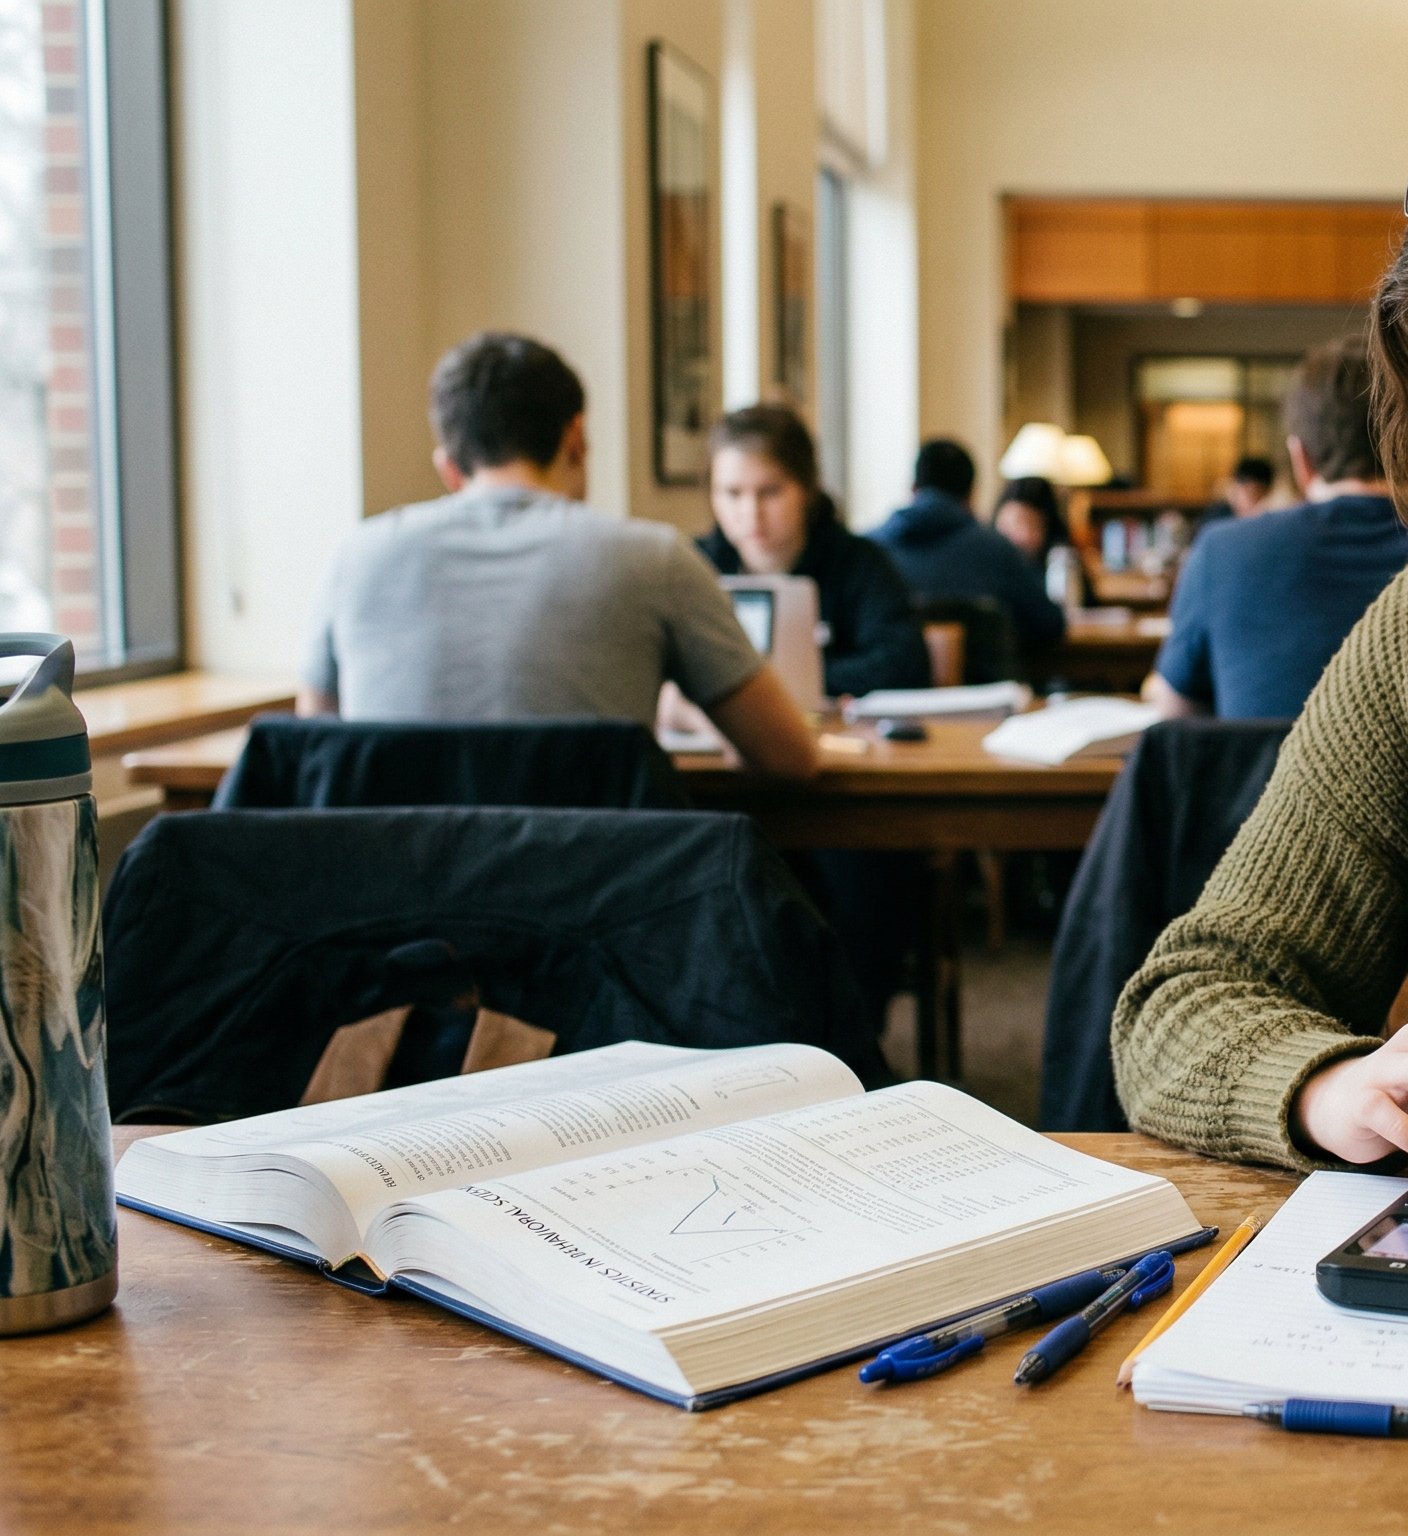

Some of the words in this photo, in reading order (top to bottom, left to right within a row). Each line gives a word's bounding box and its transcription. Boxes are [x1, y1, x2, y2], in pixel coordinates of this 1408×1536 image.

[503, 1204, 586, 1259] BEHAVIORAL
[579, 1257, 606, 1269] IN
[597, 1267, 676, 1303] STATISTICS
